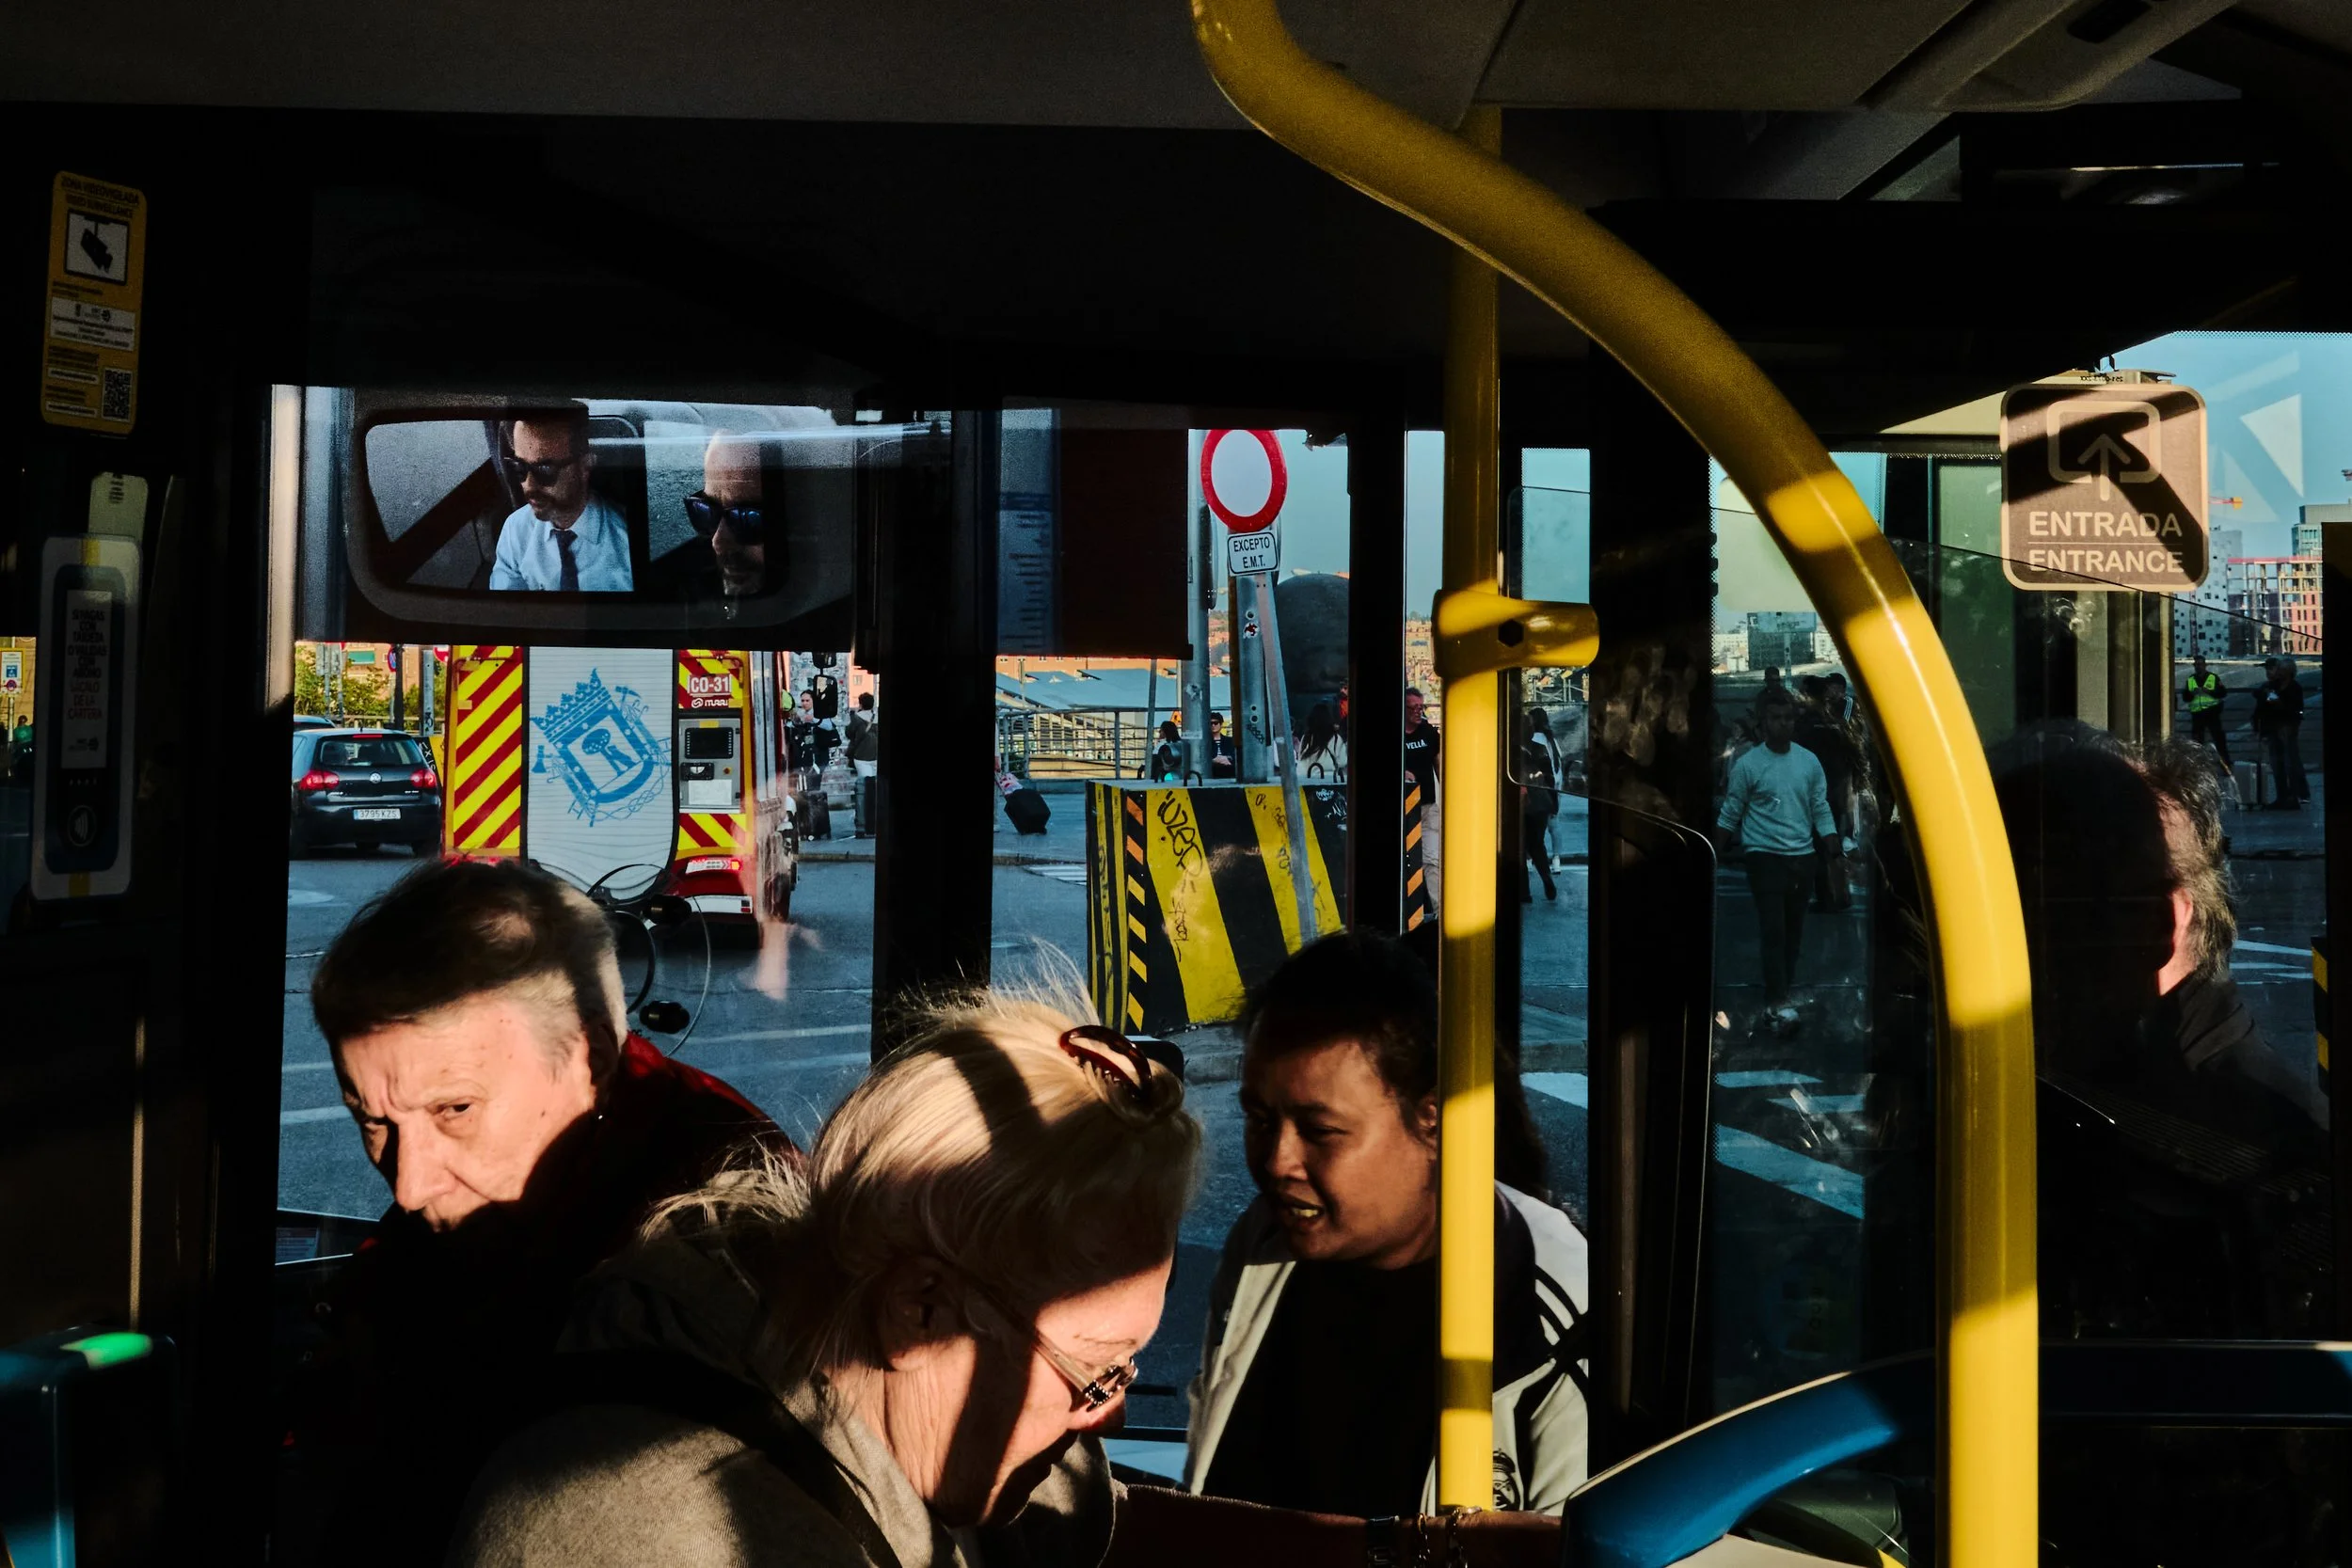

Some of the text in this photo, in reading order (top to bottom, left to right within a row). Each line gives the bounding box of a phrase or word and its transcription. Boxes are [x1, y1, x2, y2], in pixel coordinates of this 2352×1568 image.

[2028, 511, 2183, 537] ENTRADA
[1233, 537, 1270, 552] EXCEPTO
[1243, 555, 1266, 568] E.M.T.
[2028, 549, 2185, 573] ENTRANCE
[691, 676, 728, 693] CO-31
